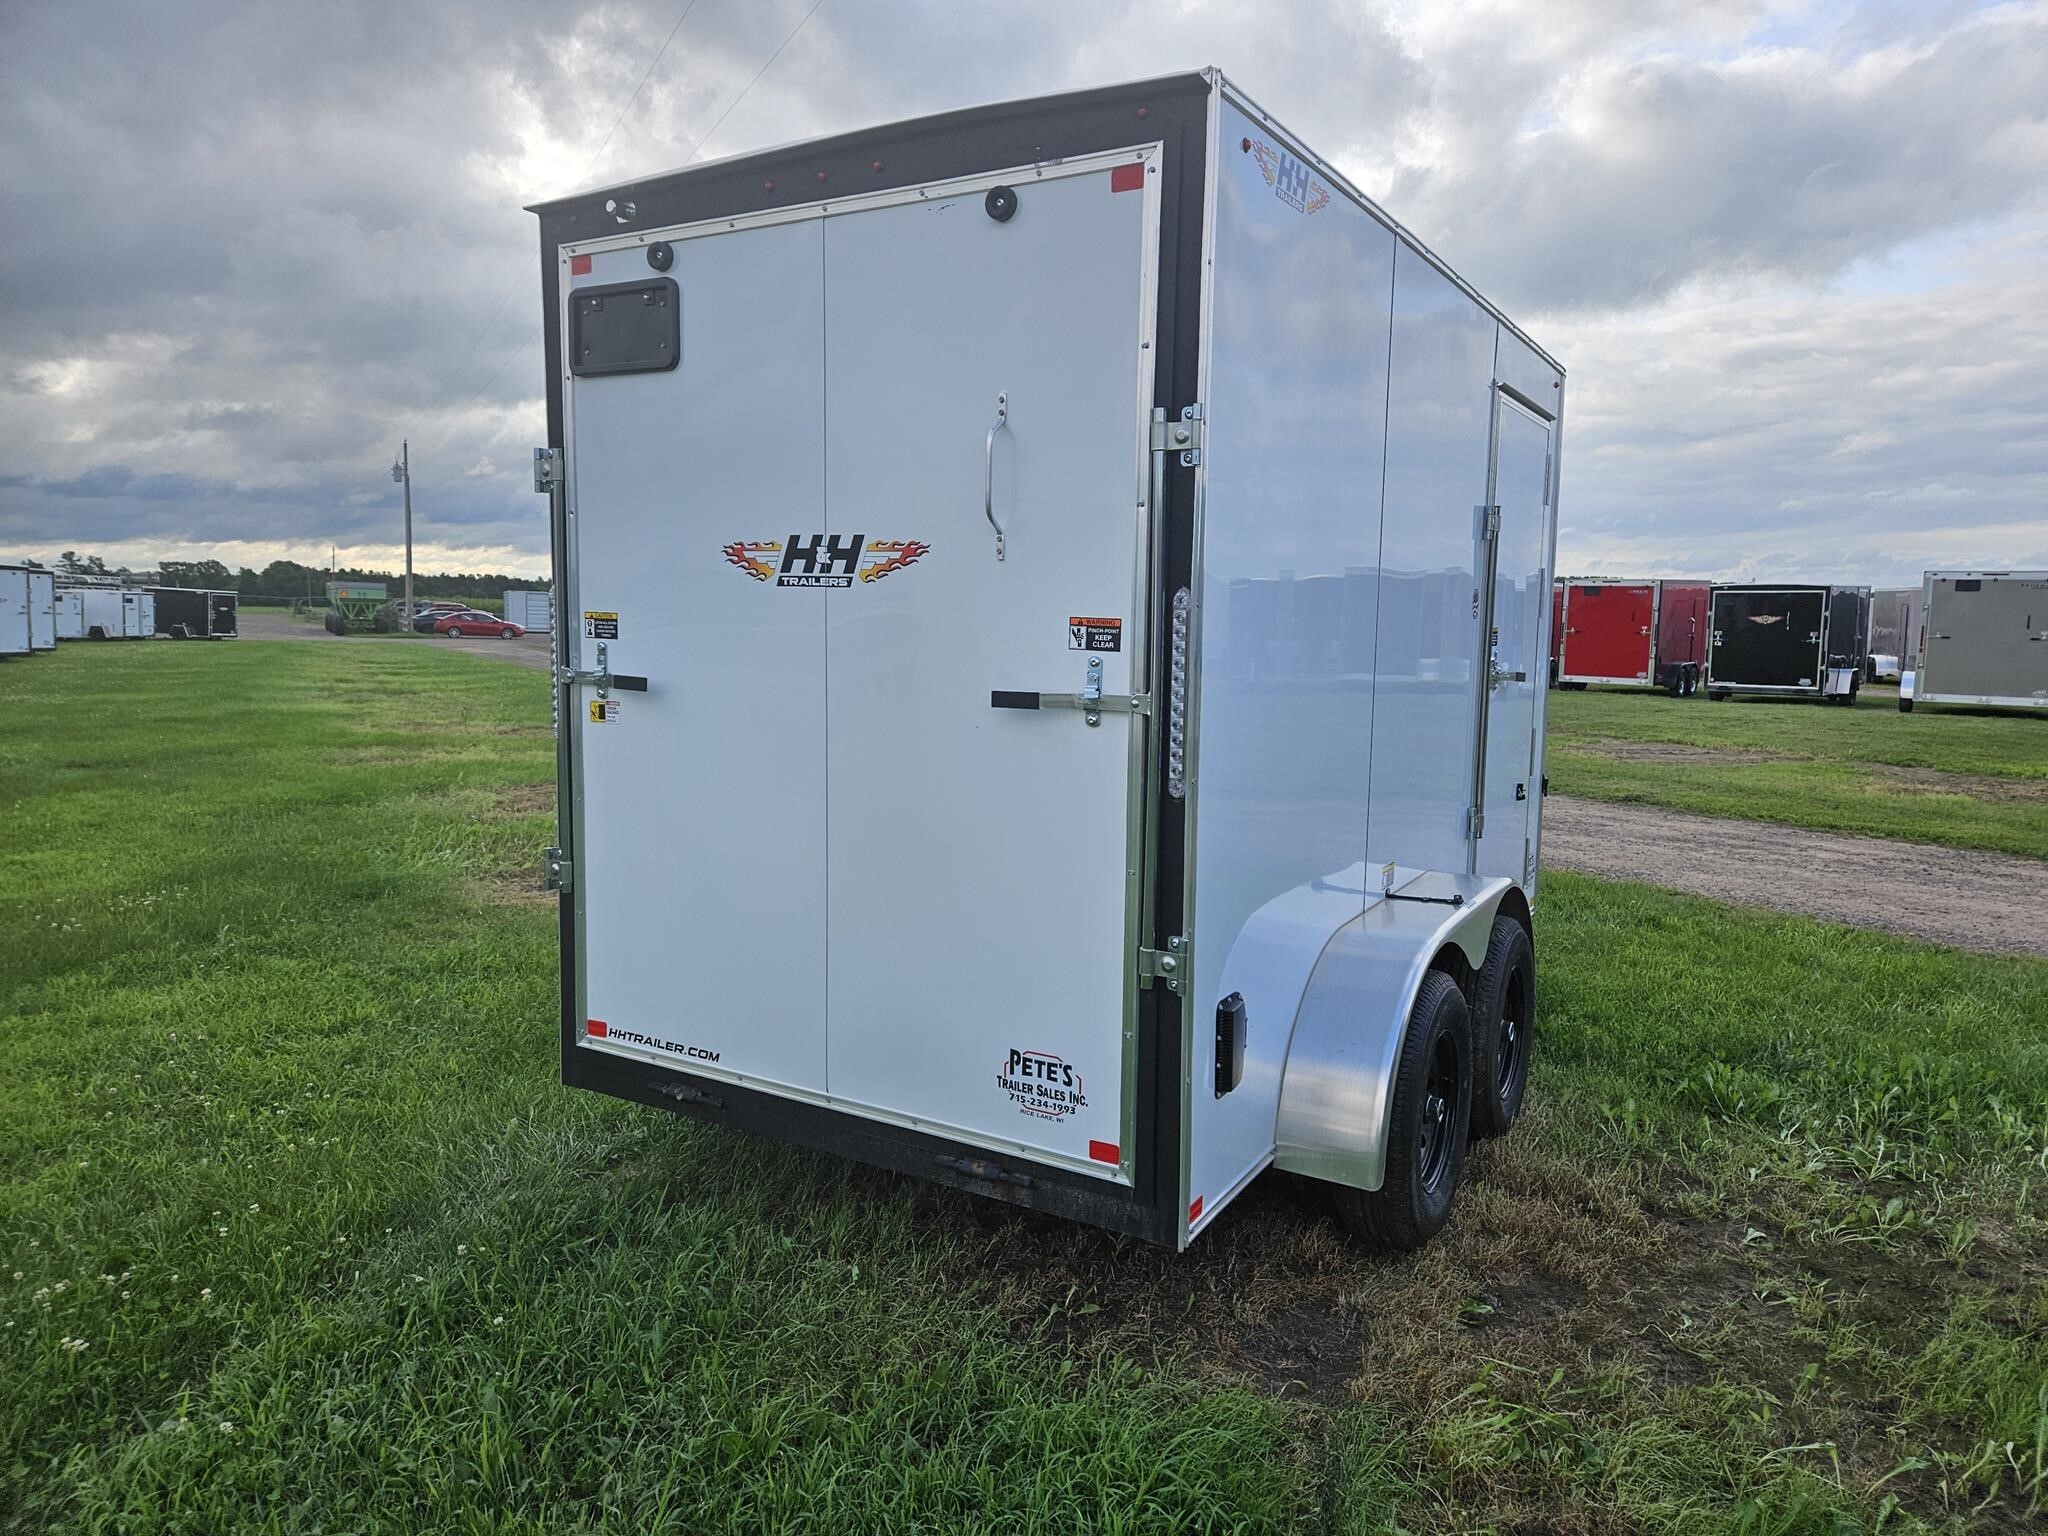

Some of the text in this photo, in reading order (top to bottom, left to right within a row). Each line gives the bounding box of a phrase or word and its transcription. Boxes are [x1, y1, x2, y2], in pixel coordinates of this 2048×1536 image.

[780, 534, 865, 574] H&H
[782, 576, 849, 586] TRAILERS
[1086, 618, 1116, 626] WARNING
[608, 1028, 720, 1062] HHTRAILER.COM
[1009, 1048, 1073, 1087] PETE'S
[997, 1075, 1089, 1107] TRAILER SALES INC.
[1009, 1092, 1076, 1115] 715-234-1993
[1020, 1108, 1035, 1117] RICE
[1036, 1112, 1055, 1122] LAKE,
